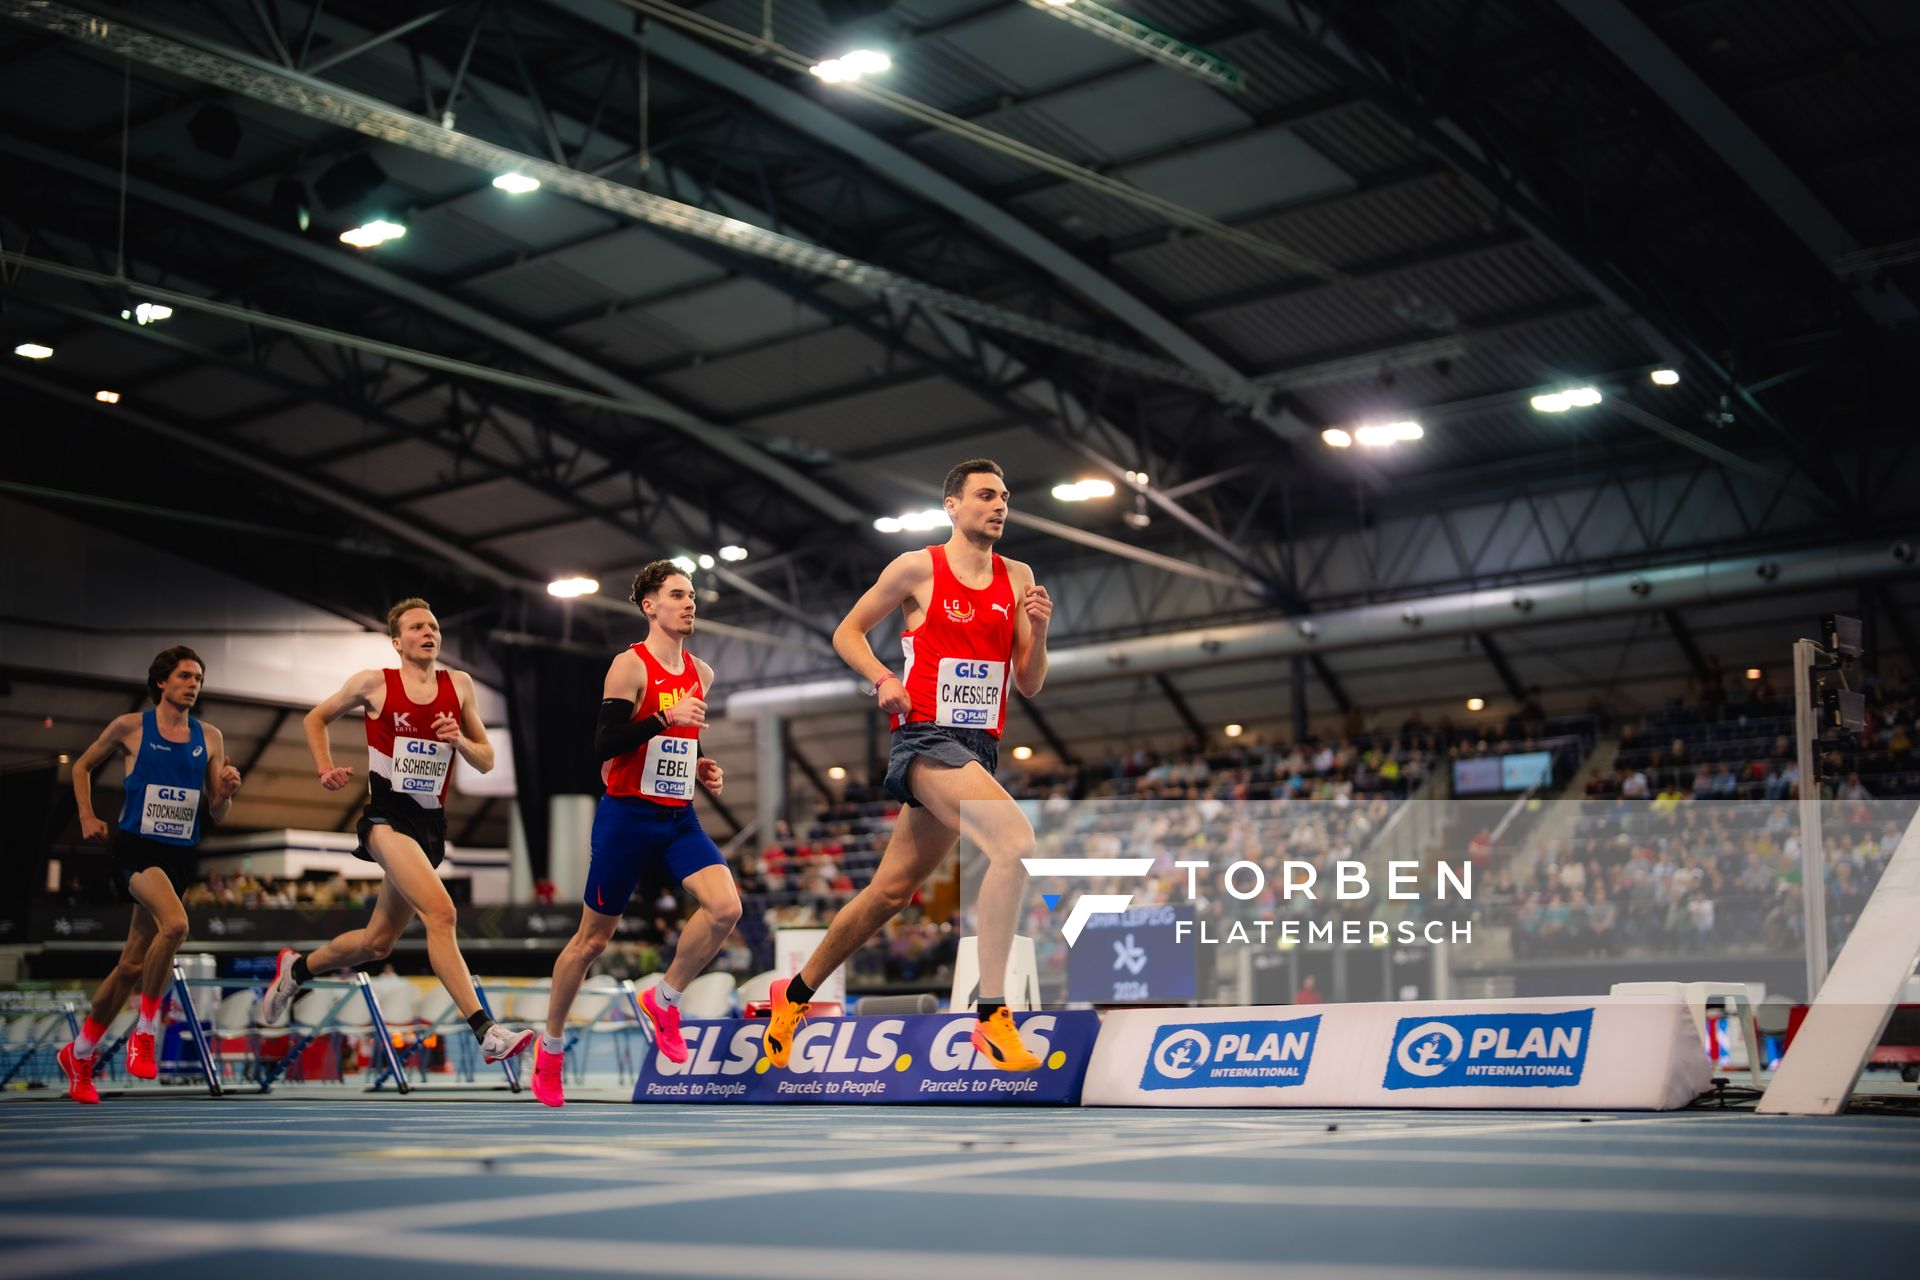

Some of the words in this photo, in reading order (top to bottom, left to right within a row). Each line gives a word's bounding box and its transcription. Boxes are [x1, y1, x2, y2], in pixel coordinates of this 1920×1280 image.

[942, 684, 999, 705] C.KESSLER
[968, 711, 987, 719] PLAN
[394, 757, 447, 777] K.SCHREINER
[656, 759, 689, 778] EBEL
[416, 780, 434, 788] PLAN
[669, 782, 685, 791] PLAN
[146, 803, 195, 821] STOCKHAUSEN
[167, 823, 183, 832] PLAN
[1214, 1031, 1310, 1062] PLAN
[1468, 1027, 1582, 1059] PLAN
[1210, 1067, 1300, 1078] INTERNATIONAL
[1466, 1065, 1574, 1076] INTERNATIONAL
[646, 1082, 688, 1095] Parcels
[689, 1083, 704, 1095] to
[704, 1082, 746, 1098] People
[777, 1080, 822, 1094] Parcels
[825, 1081, 840, 1094] to
[841, 1080, 885, 1096] People
[920, 1078, 968, 1092] Parcels
[971, 1080, 987, 1092] to
[988, 1077, 1038, 1095] People
